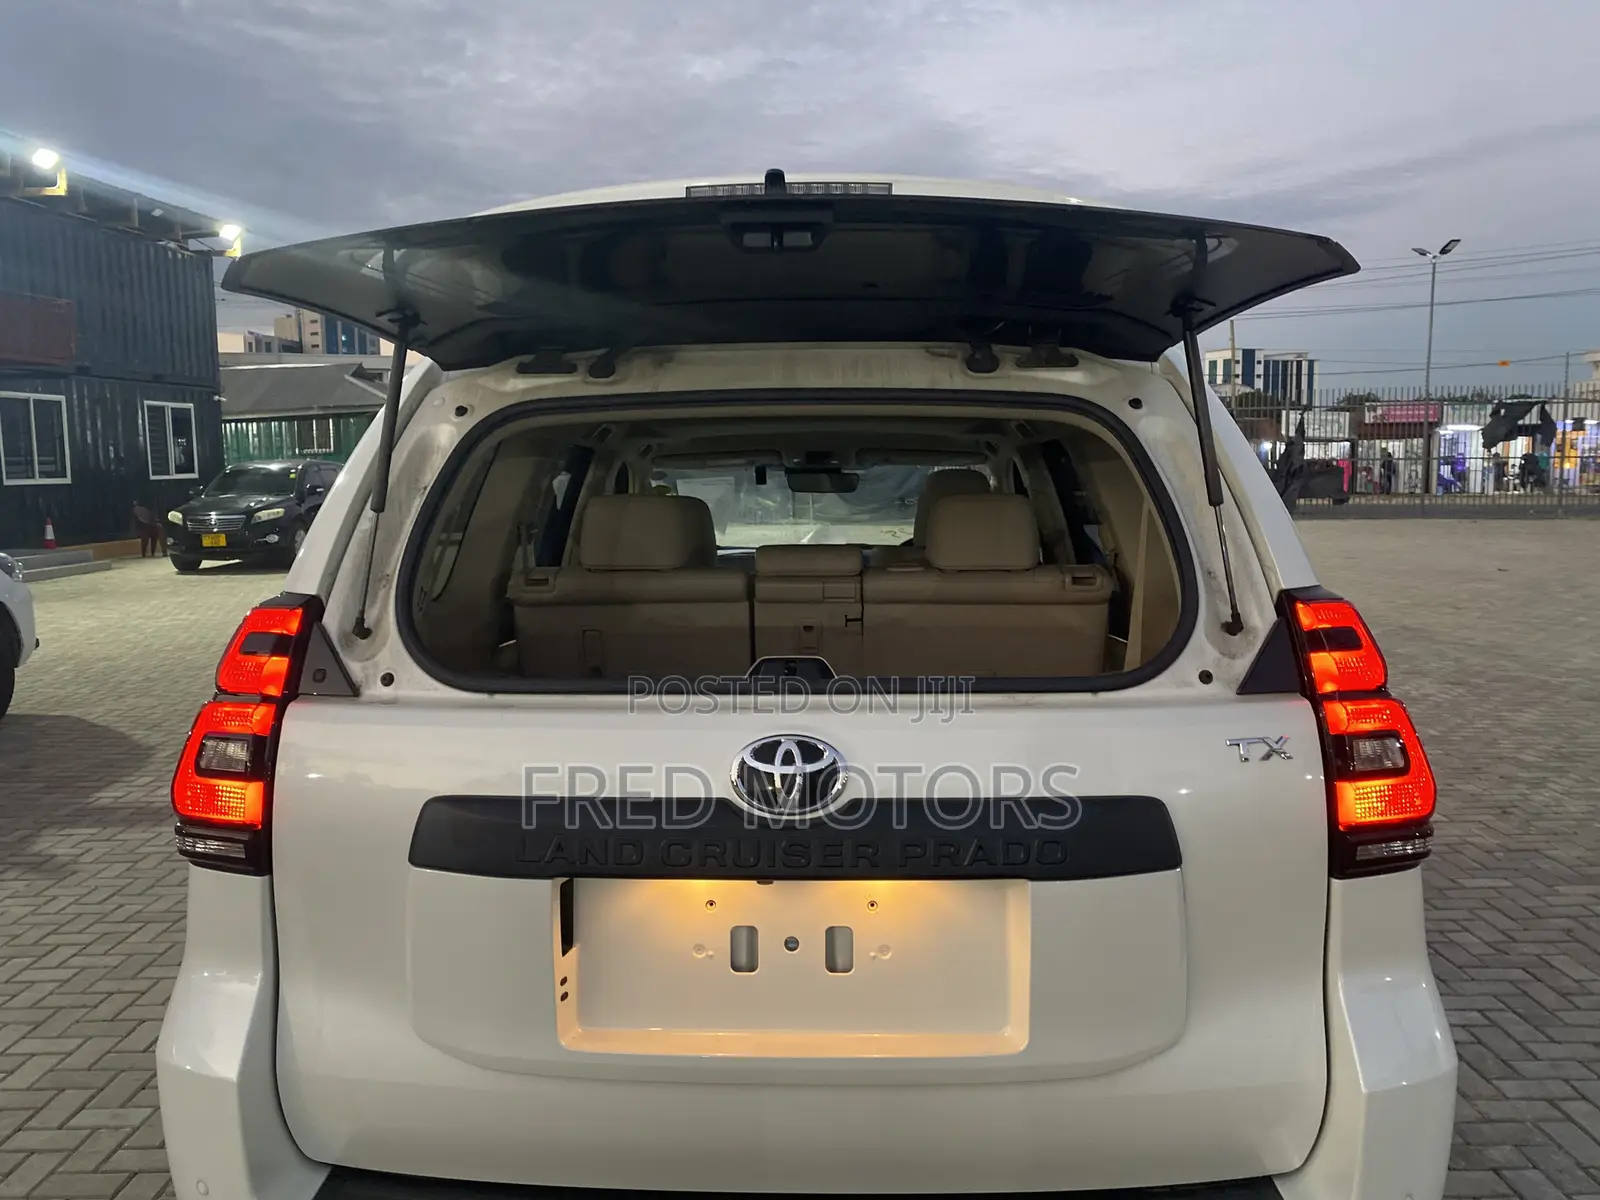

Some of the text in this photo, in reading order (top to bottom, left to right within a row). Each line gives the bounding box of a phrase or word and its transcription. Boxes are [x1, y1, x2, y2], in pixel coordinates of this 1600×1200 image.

[1225, 734, 1293, 762] TX
[516, 836, 1069, 869] LAND CRUISER PRADO
